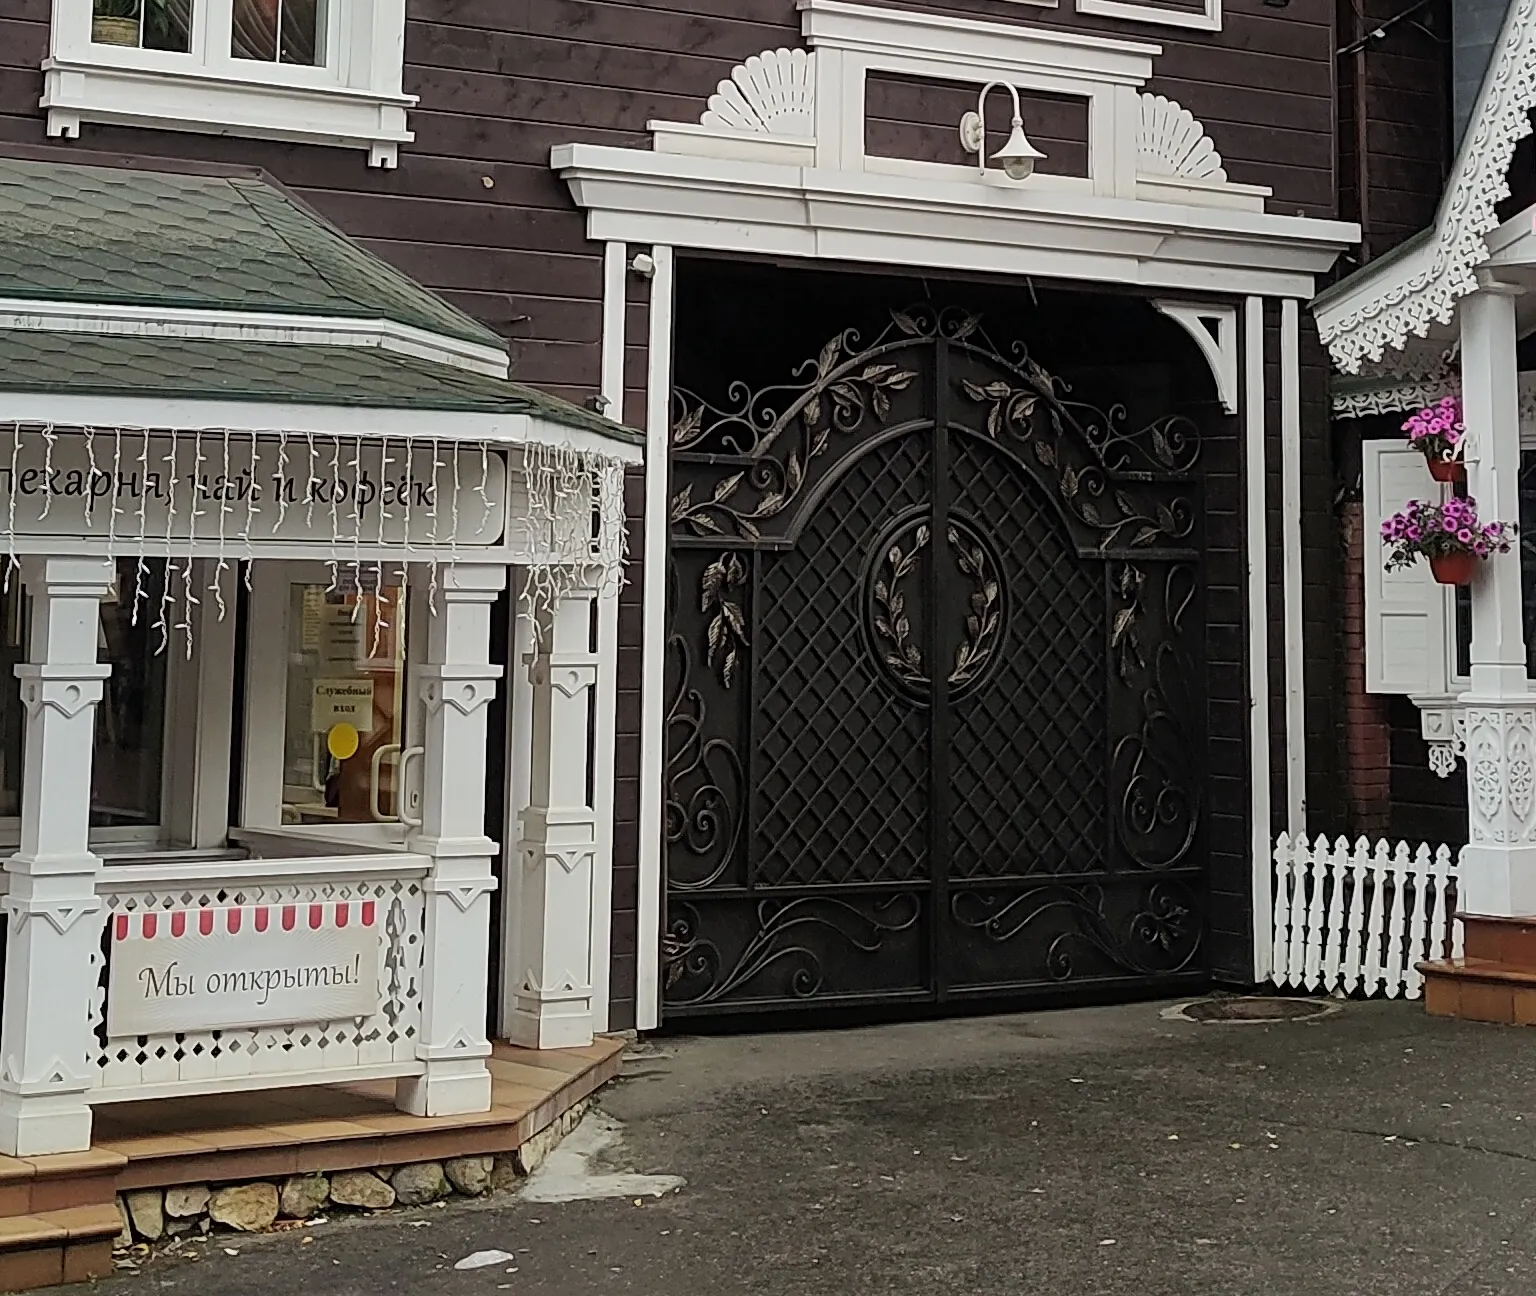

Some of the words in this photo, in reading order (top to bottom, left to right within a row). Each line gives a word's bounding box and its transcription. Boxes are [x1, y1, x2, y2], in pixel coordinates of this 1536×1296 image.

[188, 470, 261, 503] чай
[271, 475, 298, 503] и
[310, 470, 436, 519] кофеёк
[316, 685, 372, 698] Служебный
[138, 962, 195, 998] Мы
[206, 954, 360, 1005] открыты!
